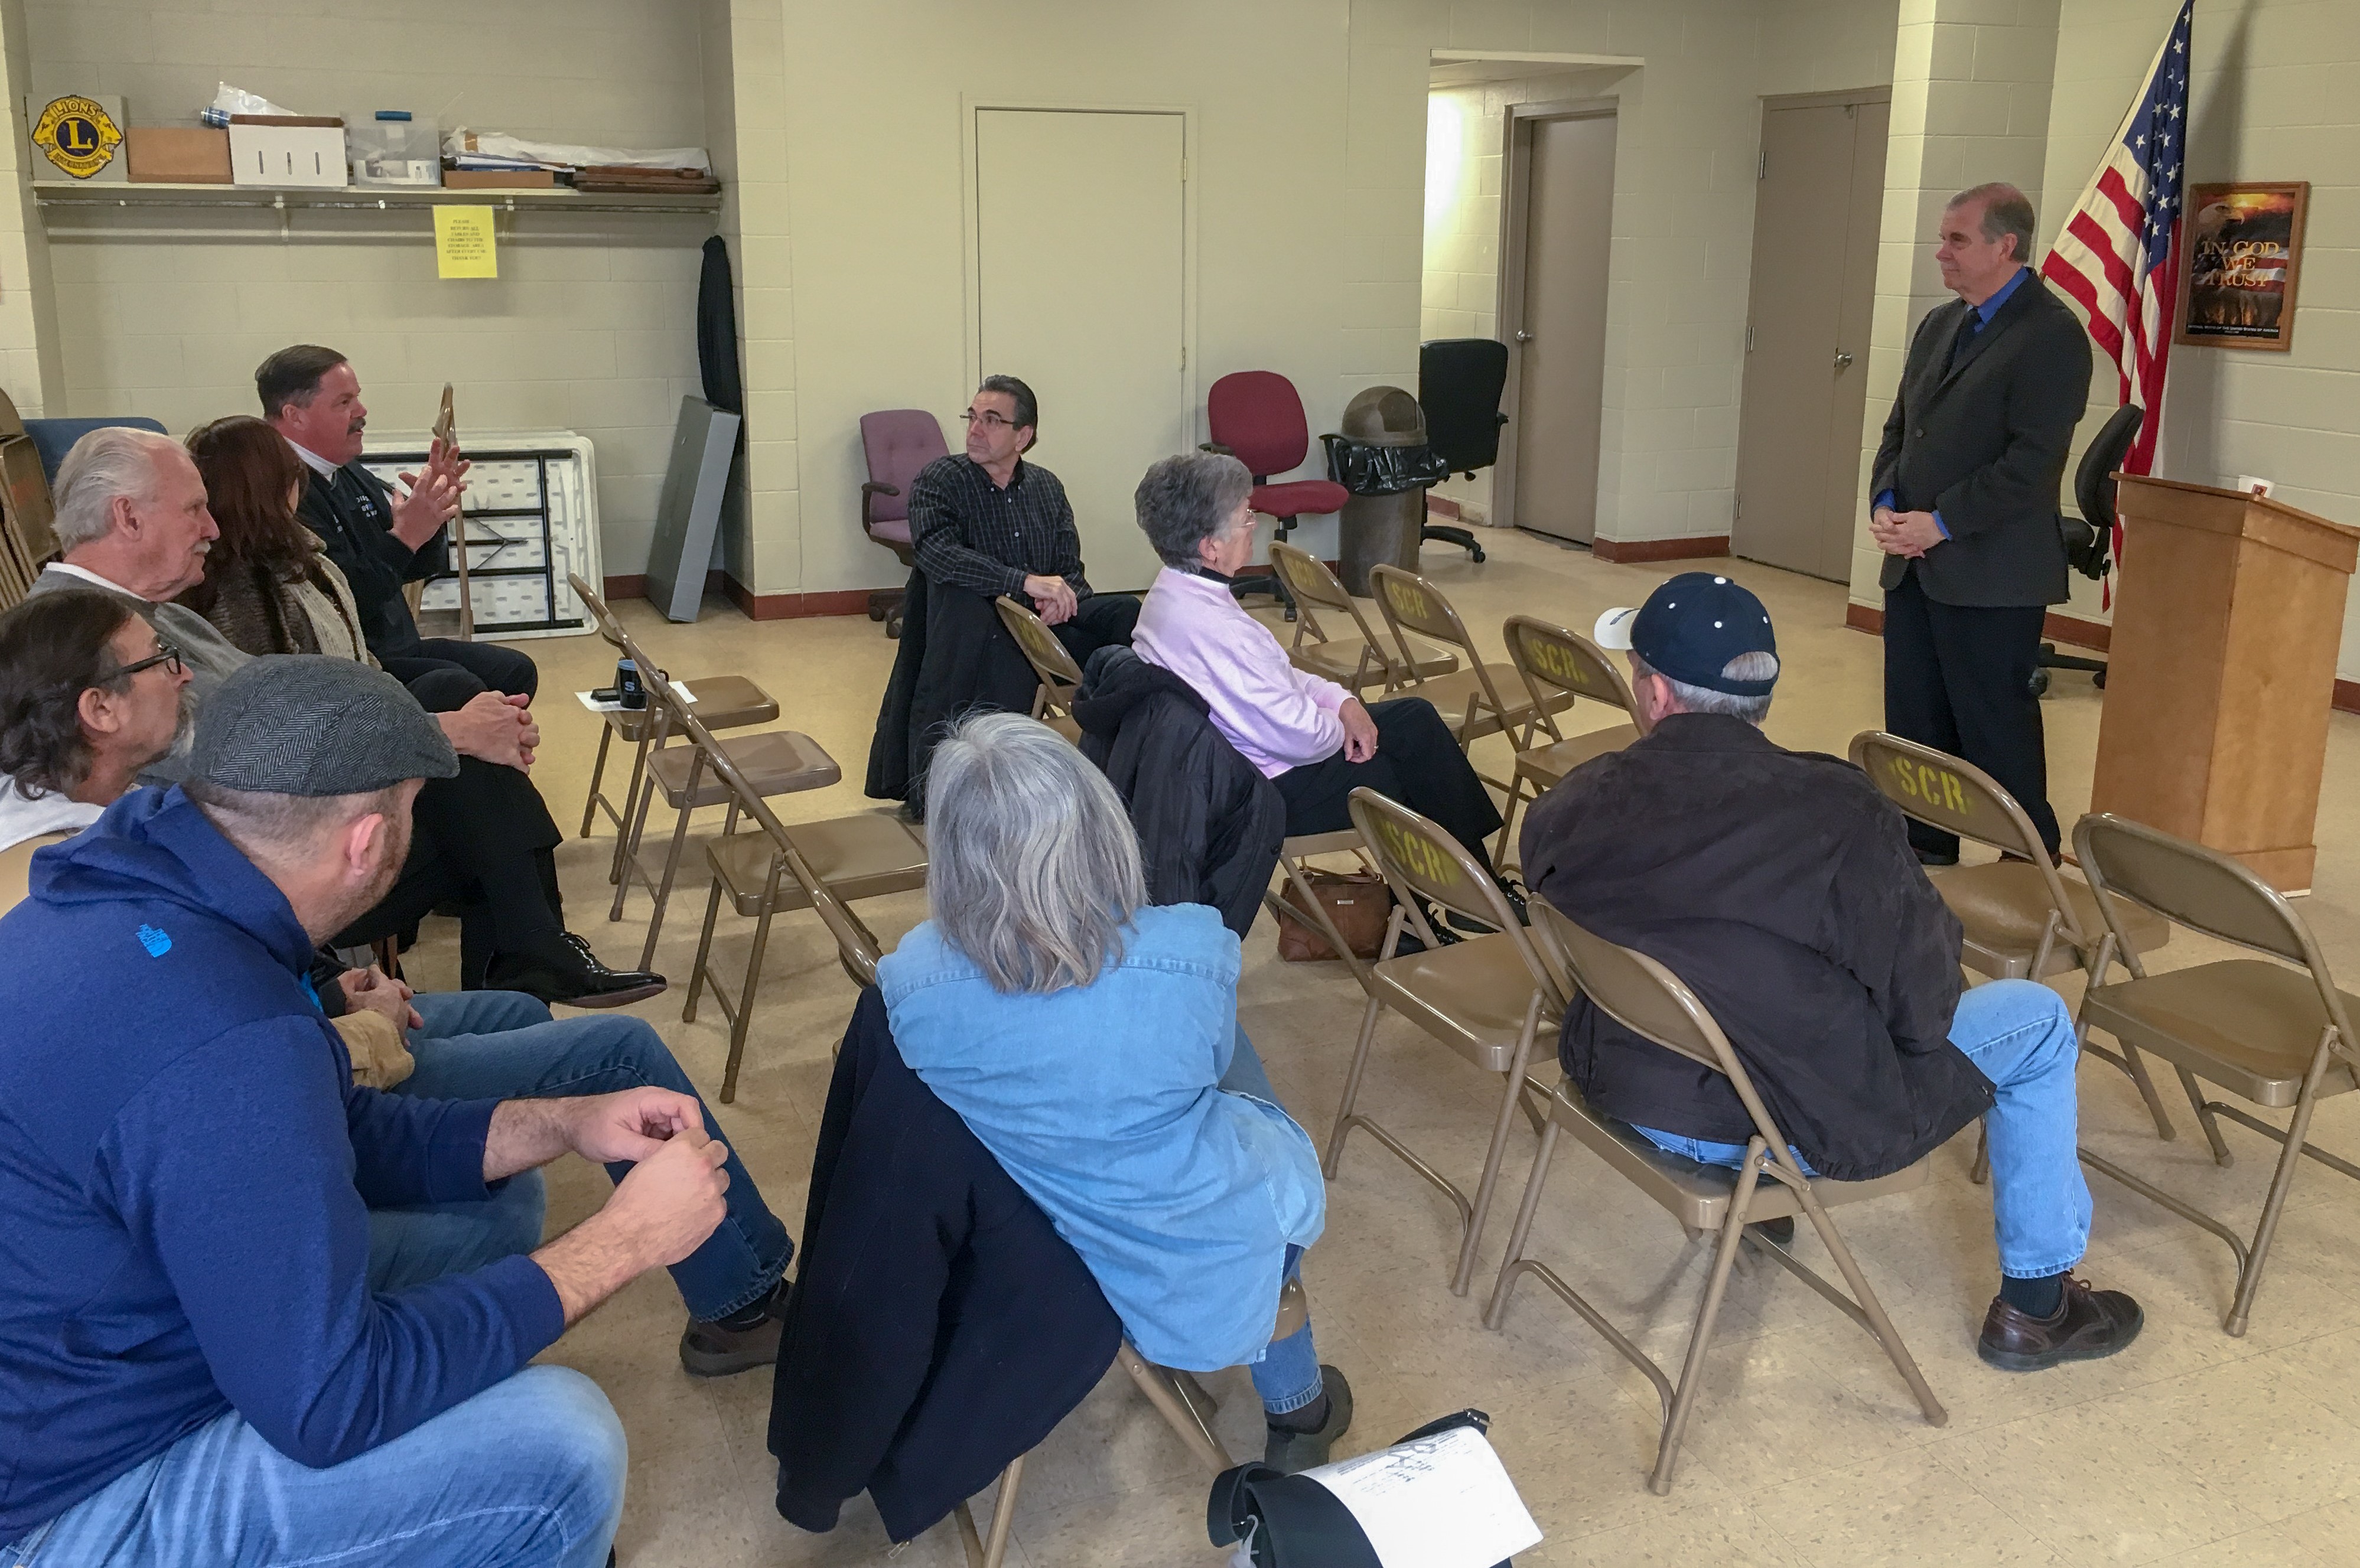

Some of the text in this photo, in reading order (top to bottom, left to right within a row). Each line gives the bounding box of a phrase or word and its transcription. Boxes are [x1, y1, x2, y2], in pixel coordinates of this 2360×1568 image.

[52, 100, 99, 116] LIONS
[66, 120, 93, 149] L
[2202, 240, 2279, 256] IN GOD
[2222, 257, 2255, 270] WE
[2207, 272, 2269, 287] TRUST
[1391, 581, 1428, 620] SCR
[1531, 638, 1581, 683] SCR
[624, 681, 636, 692] S
[1895, 755, 1967, 815] SCR
[1385, 820, 1447, 886] SCR
